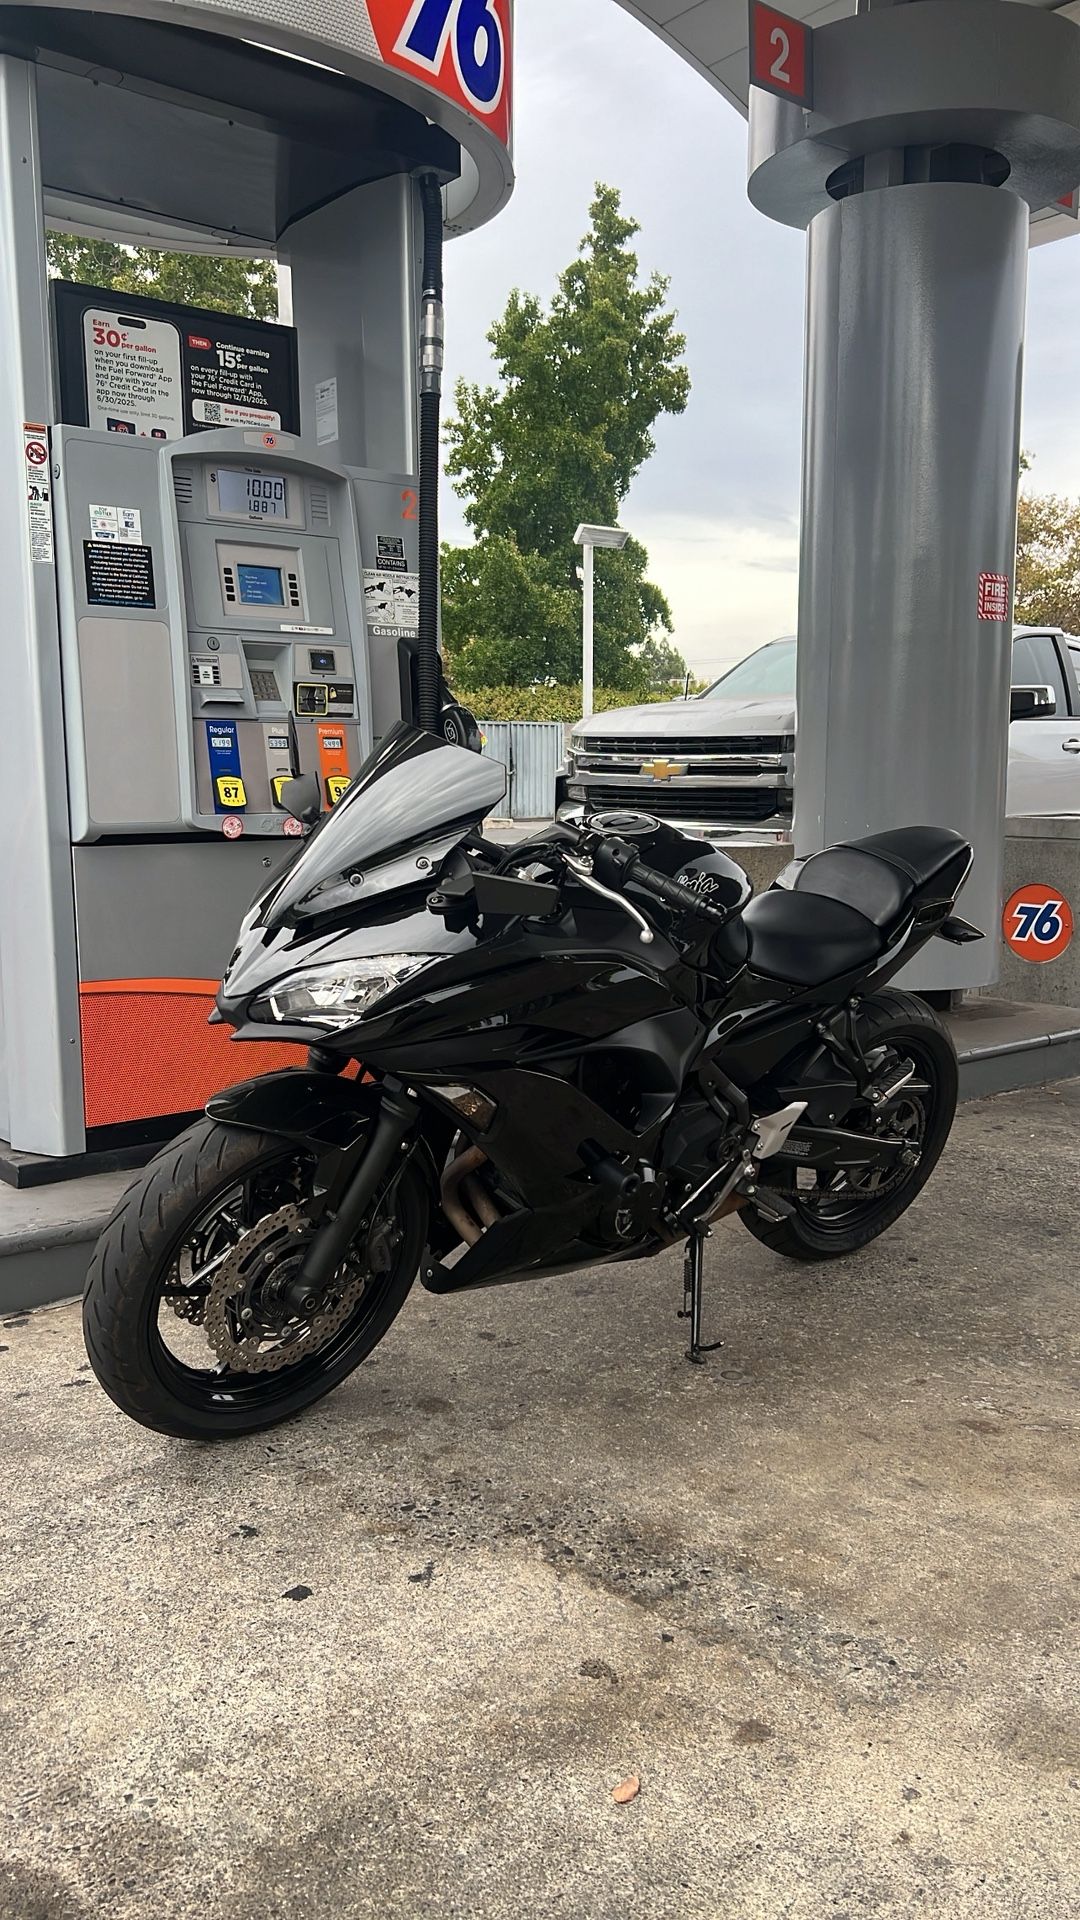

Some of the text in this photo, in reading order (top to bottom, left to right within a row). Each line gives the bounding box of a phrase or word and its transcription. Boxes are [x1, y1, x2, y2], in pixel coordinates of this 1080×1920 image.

[770, 27, 790, 83] 2
[93, 319, 110, 328] Earn
[135, 344, 156, 353] gallon
[216, 342, 270, 359] Continue earning
[138, 355, 157, 365] fill-up
[130, 362, 163, 373] download
[249, 365, 268, 373] gallon
[220, 369, 238, 378] fill-up
[219, 377, 238, 386] Credit
[110, 382, 130, 390] Credit
[158, 389, 169, 397] the
[207, 389, 232, 399] through
[128, 391, 155, 403] through
[210, 473, 282, 500] $ 10.00
[401, 488, 417, 520] 2
[378, 559, 405, 567] CONTAINS
[985, 582, 1005, 597] FIRE
[984, 602, 1004, 612] INSIDE
[373, 626, 415, 637] Gasoline
[209, 726, 234, 735] Regular
[224, 787, 239, 799] 87
[1011, 900, 1063, 944] 76
